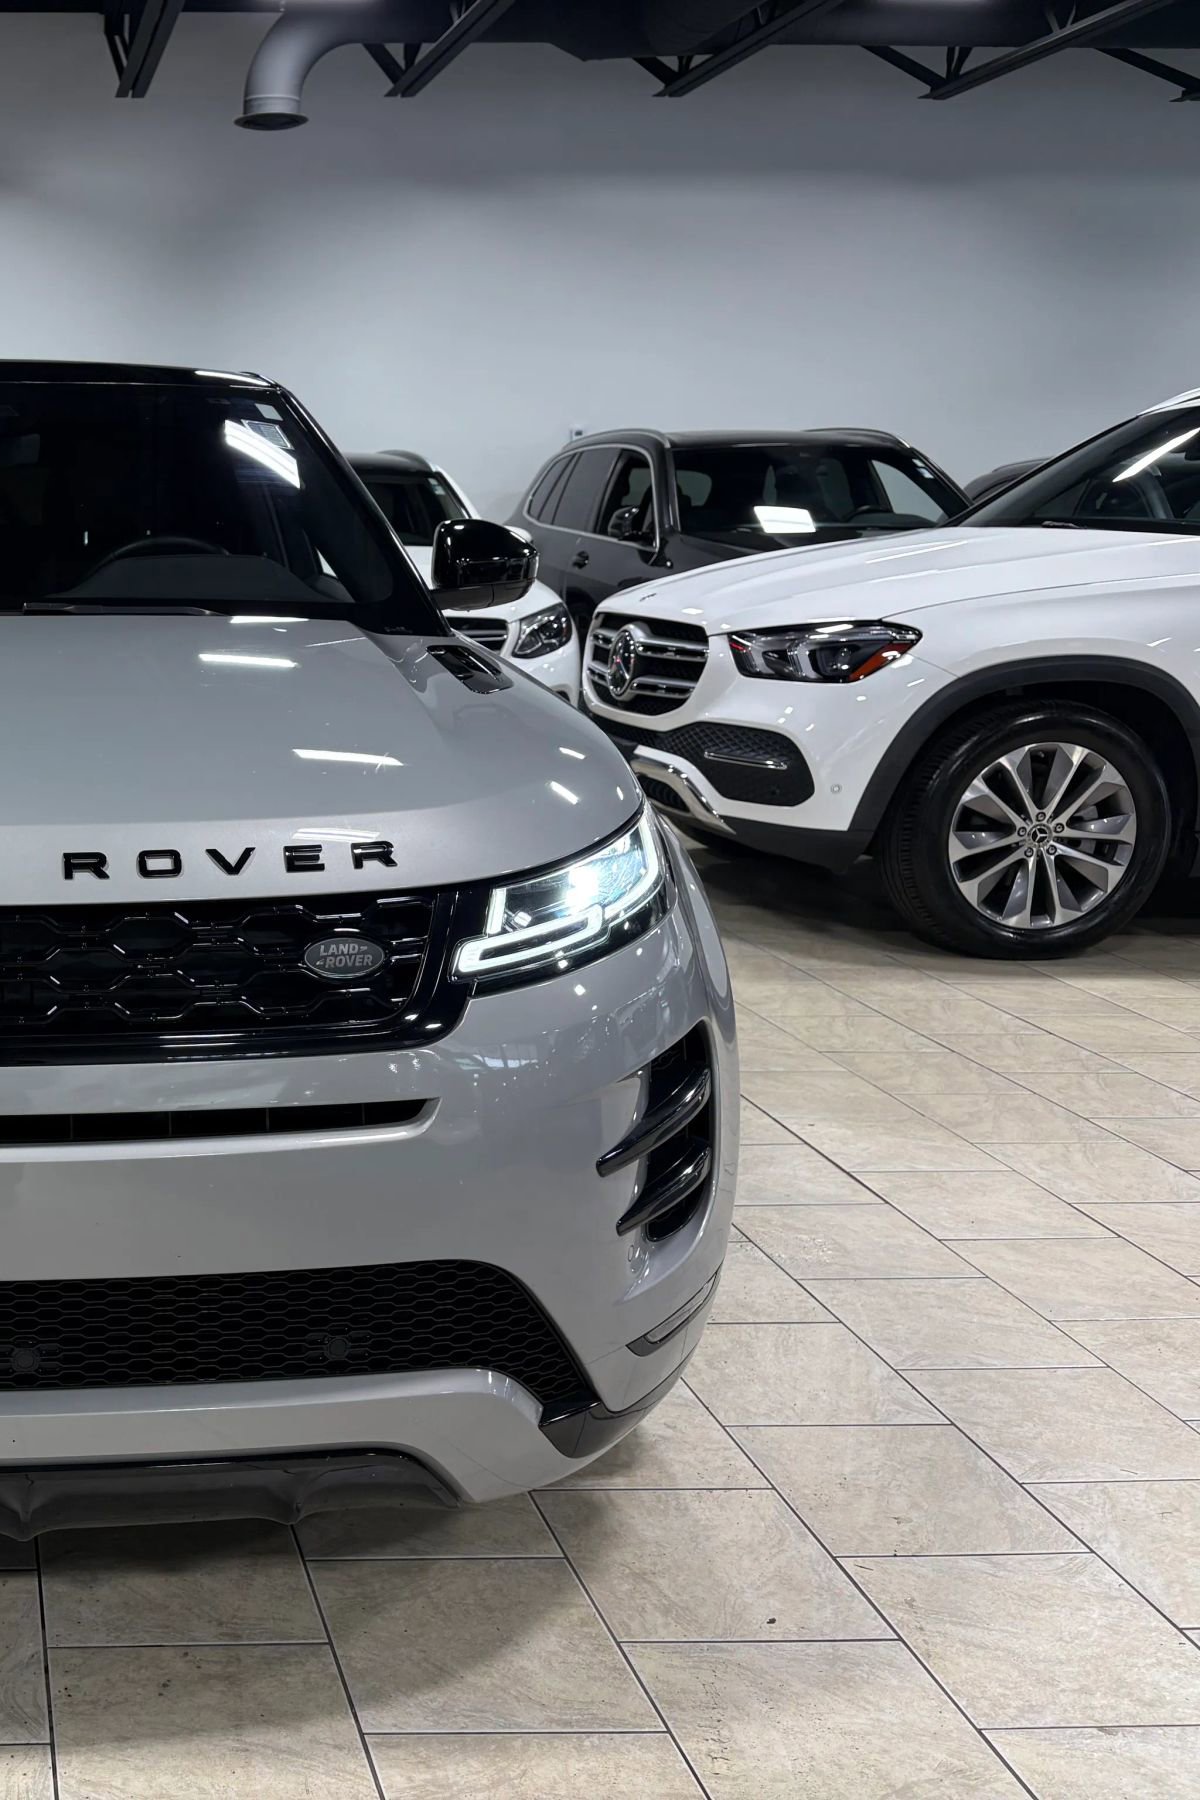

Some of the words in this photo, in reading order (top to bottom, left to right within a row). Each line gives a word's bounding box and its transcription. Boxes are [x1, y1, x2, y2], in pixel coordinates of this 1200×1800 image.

[63, 841, 398, 880] ROVER
[320, 944, 359, 956] LAND
[325, 954, 373, 969] ROVER
